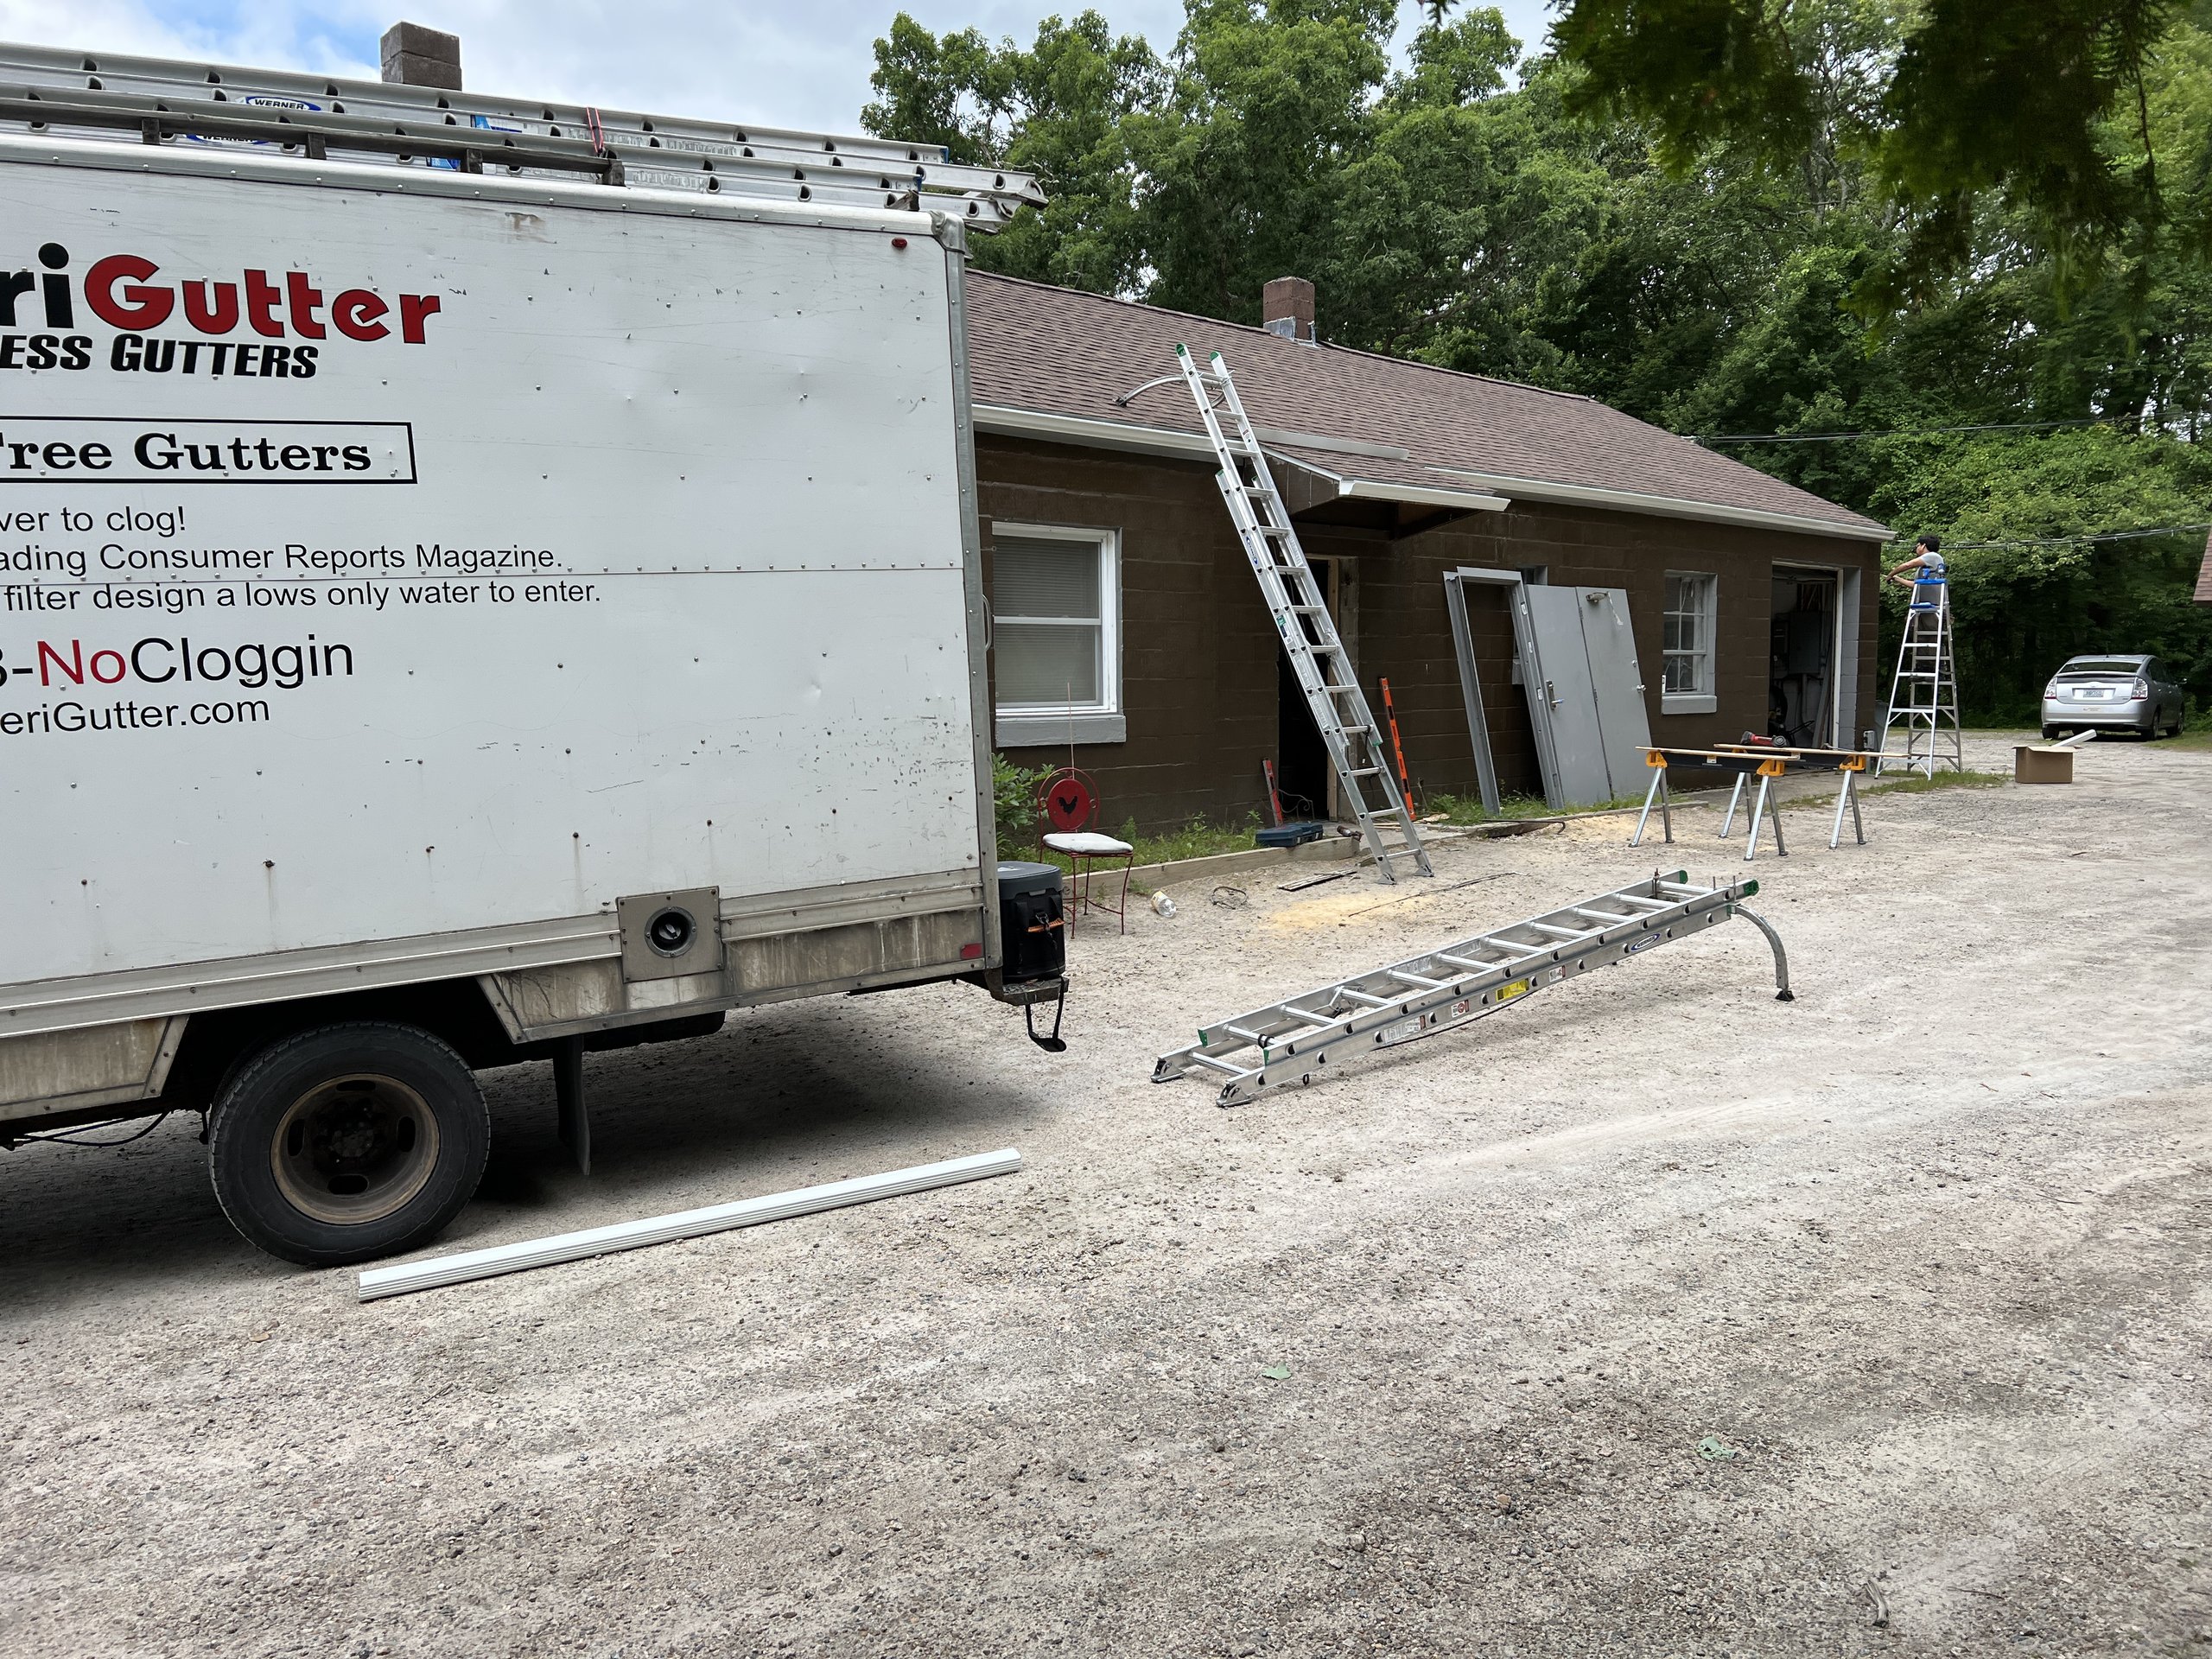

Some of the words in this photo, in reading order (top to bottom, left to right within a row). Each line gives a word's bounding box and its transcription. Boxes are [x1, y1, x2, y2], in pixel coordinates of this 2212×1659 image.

[255, 99, 304, 110] WERNER
[0, 334, 93, 371] ESS
[111, 333, 319, 378] GUTTERS
[0, 431, 112, 470] ree
[134, 432, 372, 471] Gutters
[60, 506, 93, 532] to
[106, 505, 187, 537] clog!
[99, 543, 275, 570] Consumer
[284, 544, 406, 575] Reports
[416, 544, 563, 574] Magazine.
[4, 584, 80, 611] filter
[92, 583, 206, 614] design
[327, 581, 390, 612] only
[398, 584, 480, 605] water
[488, 581, 515, 603] to
[524, 585, 602, 603] enter.
[0, 633, 353, 690] -NoCloggin
[0, 700, 270, 735] eriGutter.com
